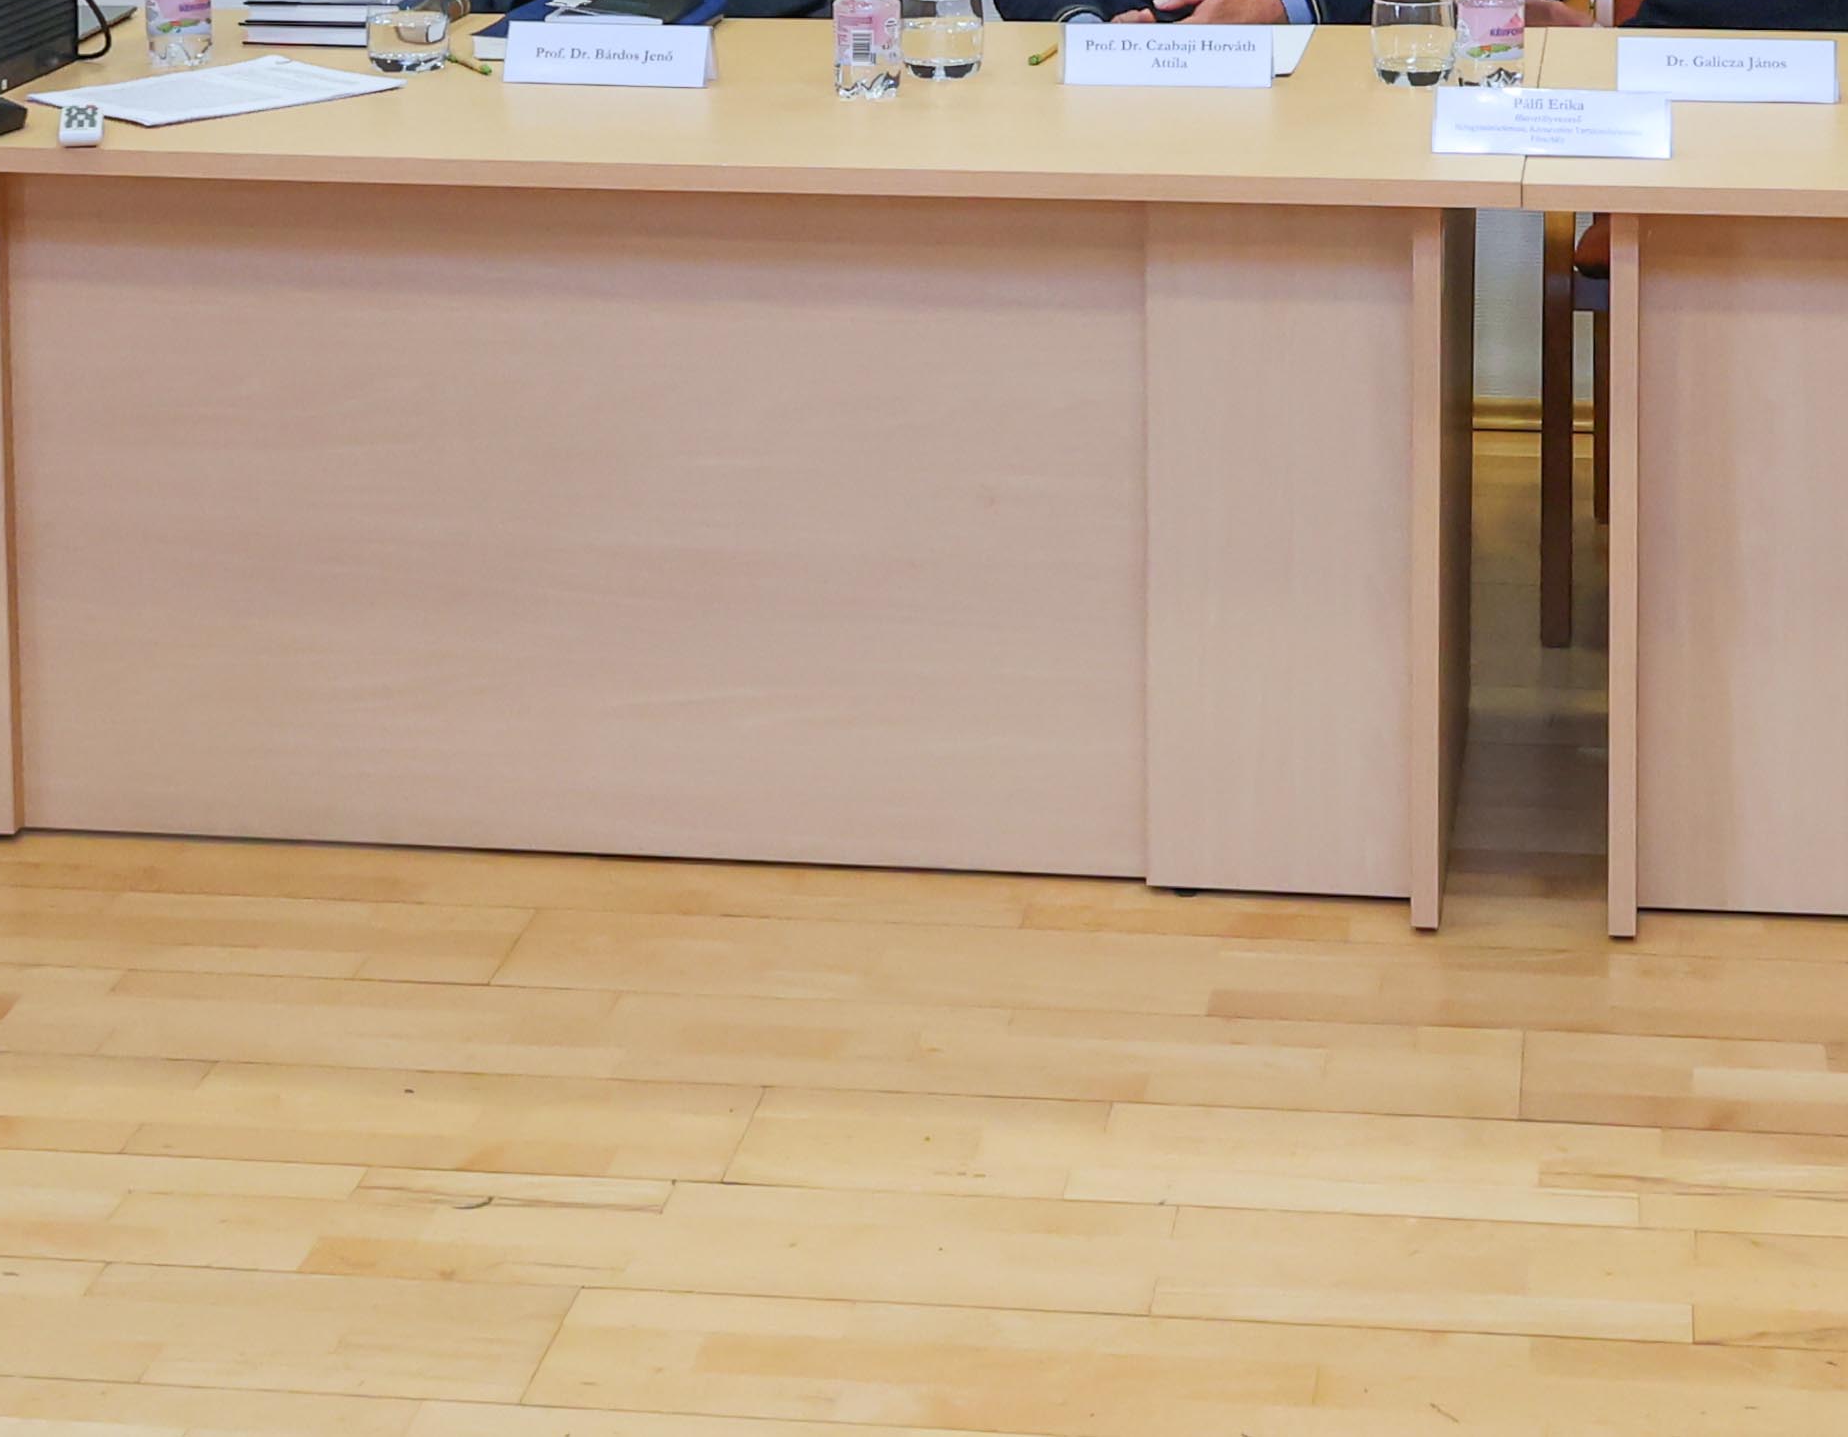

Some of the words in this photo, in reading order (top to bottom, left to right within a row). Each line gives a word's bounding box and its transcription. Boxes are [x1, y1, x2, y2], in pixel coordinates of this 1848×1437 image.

[1085, 39, 1116, 51] Prof.
[1120, 39, 1141, 52] Dr.
[1201, 40, 1256, 52] Horváth
[536, 47, 565, 59] Prof.
[570, 48, 590, 60] Dr.
[595, 48, 639, 61] Bárdos
[1151, 57, 1188, 68] Attila
[1666, 55, 1688, 67] Dr.
[1692, 54, 1744, 68] Galicza
[1747, 56, 1788, 71] János
[1514, 97, 1543, 110] Pálfi
[1548, 98, 1584, 111] Erika
